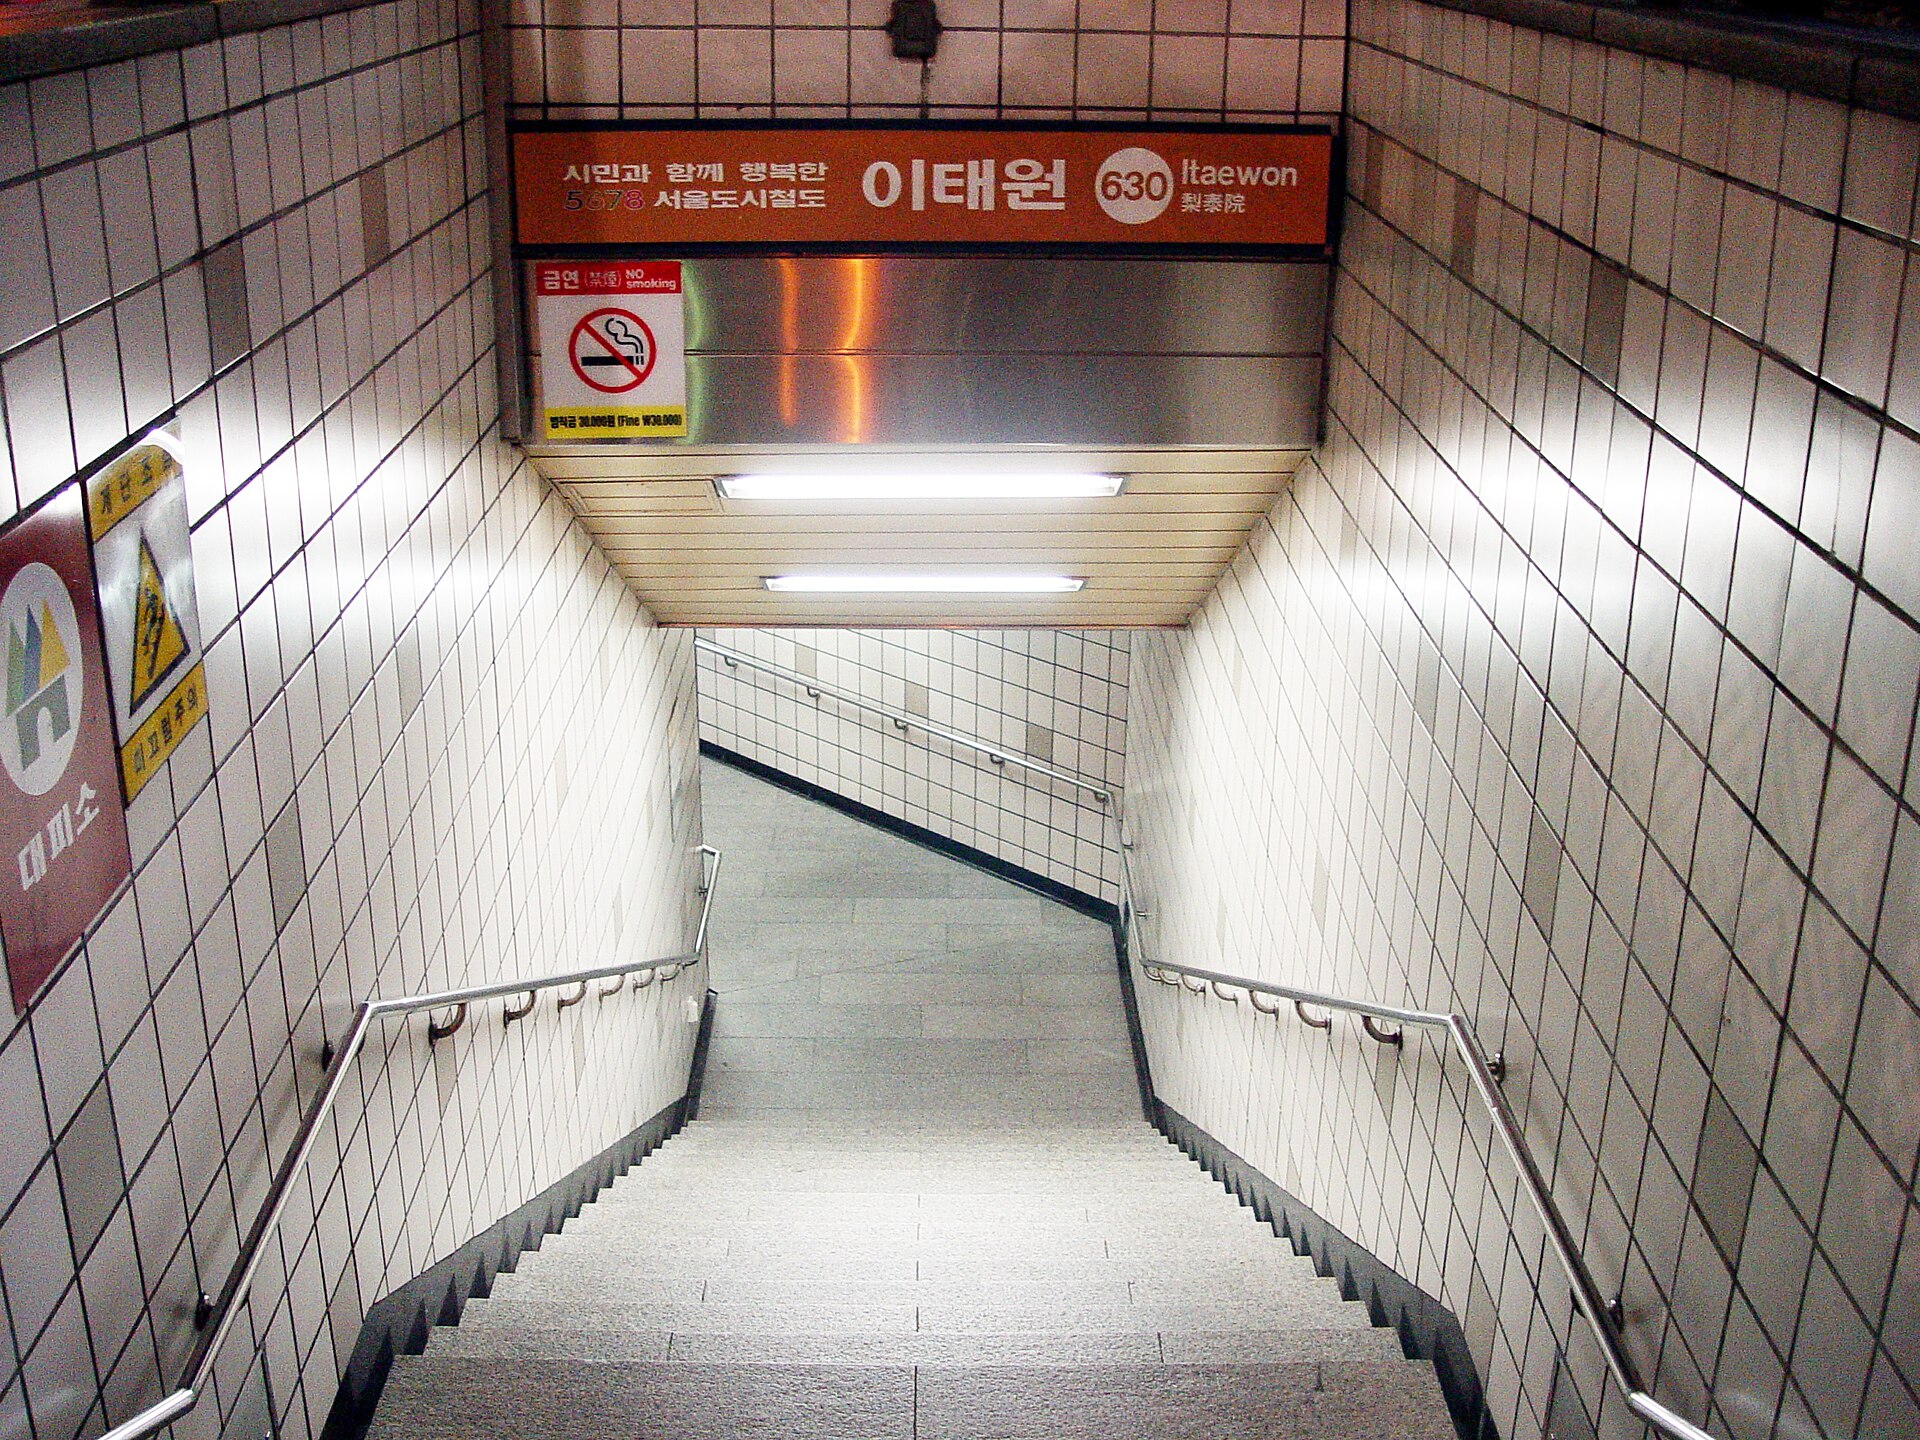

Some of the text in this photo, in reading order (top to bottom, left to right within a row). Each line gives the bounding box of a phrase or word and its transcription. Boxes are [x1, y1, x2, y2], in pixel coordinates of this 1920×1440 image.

[563, 161, 829, 184] 시민과 함께 행복한
[1181, 158, 1298, 187] Itaewon
[862, 158, 1066, 212] 이태원
[1100, 170, 1168, 202] 630
[564, 189, 826, 212] 5678 서울도시철도
[1181, 192, 1246, 214] 梨泰院
[543, 269, 579, 290] 금연
[625, 268, 645, 280] NO
[626, 278, 677, 291] smoking
[18, 781, 100, 891] 대피소
